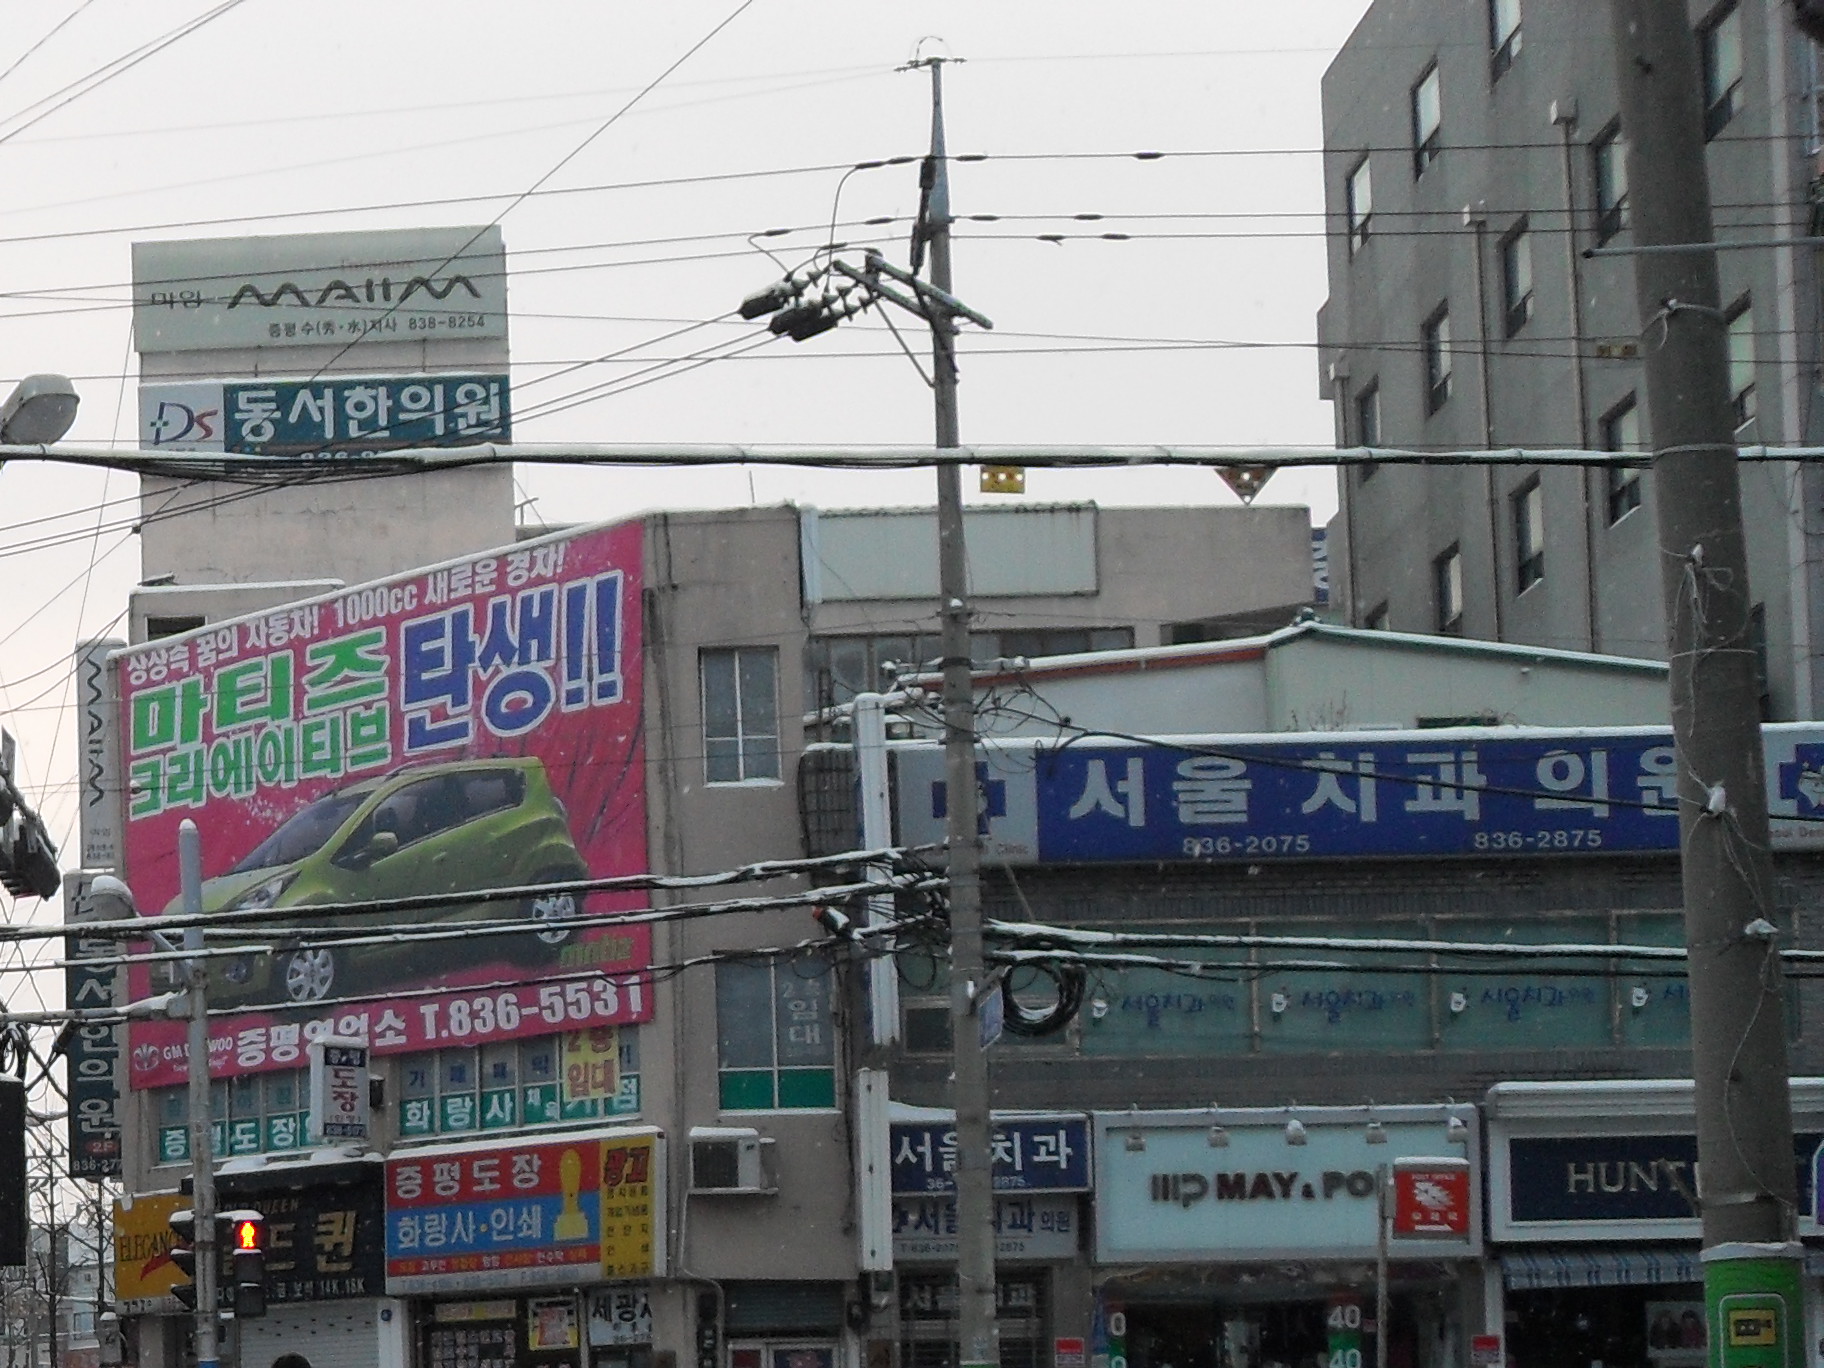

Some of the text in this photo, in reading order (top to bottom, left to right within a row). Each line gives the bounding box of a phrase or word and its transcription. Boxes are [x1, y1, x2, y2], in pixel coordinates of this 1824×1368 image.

[268, 315, 296, 339] 증평
[407, 315, 486, 332] 838-8254
[233, 381, 503, 443] 동서한의원
[196, 629, 238, 666] 꿈의
[246, 604, 319, 650] 자동차!
[334, 586, 418, 628] 1000cc
[424, 558, 497, 605] 새로운
[506, 544, 565, 586] 경차!
[130, 569, 624, 756] 마티즈 탄생!!
[130, 701, 391, 820] 크리에이티브
[1070, 757, 1252, 827] 서울
[1304, 752, 1487, 823] 치과
[1182, 829, 1602, 856] 836-2075 836-2875
[163, 1044, 183, 1060] GM
[419, 976, 643, 1040] T.836-5531
[788, 998, 821, 1045] 임대
[331, 1068, 359, 1112] 도장
[568, 1059, 616, 1098] 임대
[405, 1089, 513, 1131] 화랑사
[92, 1142, 114, 1153] 2F
[395, 1153, 542, 1199] 증평도장
[1217, 1171, 1299, 1200] MAY
[1040, 1210, 1071, 1232] 의원
[1328, 1304, 1361, 1329] 40
